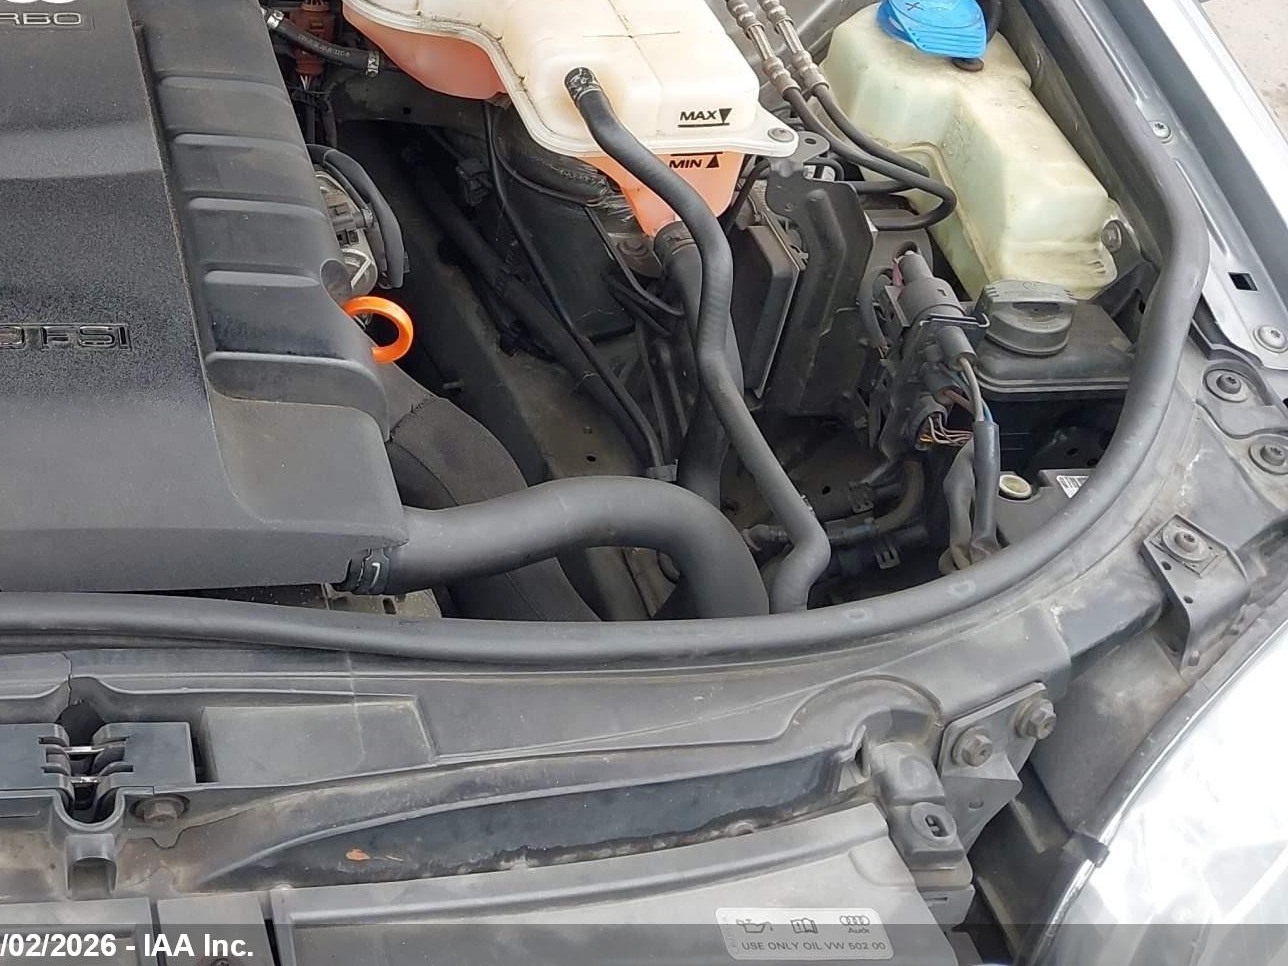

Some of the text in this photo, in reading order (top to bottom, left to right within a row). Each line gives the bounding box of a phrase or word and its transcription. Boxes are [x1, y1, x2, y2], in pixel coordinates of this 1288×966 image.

[679, 109, 718, 121] MAX
[669, 159, 703, 169] MIN
[39, 325, 132, 350] FSI
[741, 941, 886, 950] USE ONLY OIL VW 502 00
